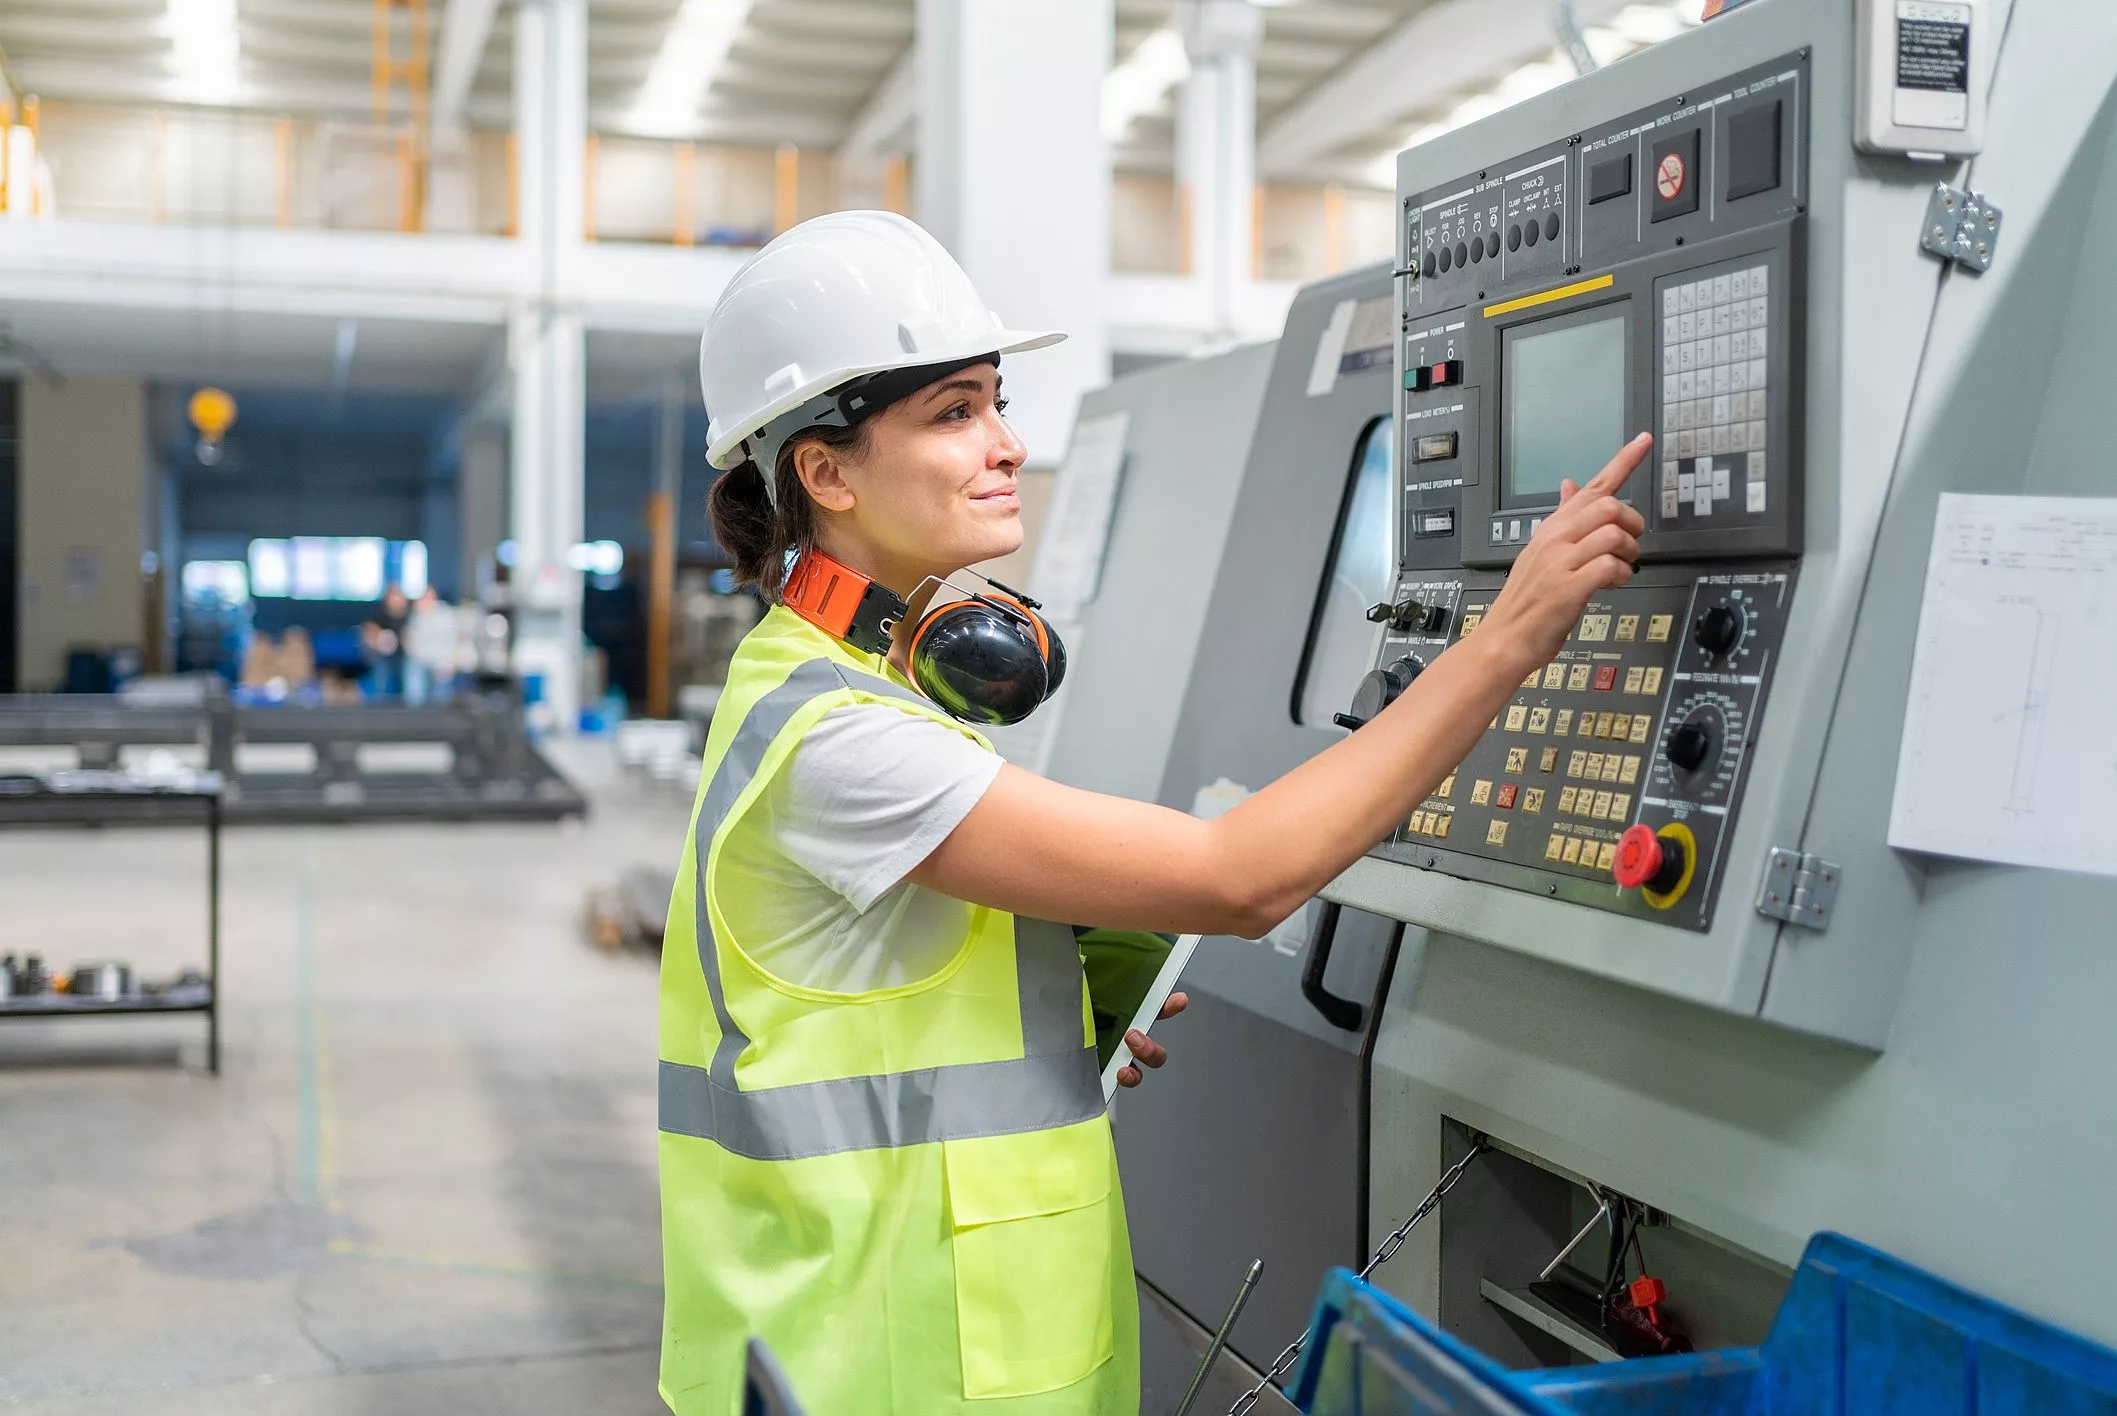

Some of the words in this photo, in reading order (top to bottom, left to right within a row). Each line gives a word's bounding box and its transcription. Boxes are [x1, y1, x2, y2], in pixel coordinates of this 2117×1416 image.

[1749, 76, 1776, 93] COUNTER
[1656, 115, 1672, 127] WORK
[1673, 105, 1697, 121] COUNTER
[1592, 138, 1606, 149] TOTAL
[1608, 130, 1630, 145] COUNTER
[1475, 183, 1485, 194] SUB
[1486, 176, 1503, 190] SPINDLE
[1521, 178, 1537, 191] CHUCK
[1554, 184, 1562, 192] EXT
[1508, 197, 1521, 208] CLAMP
[1523, 191, 1541, 203] UNCLAMP
[1439, 206, 1456, 220] SPINDLE
[1489, 205, 1499, 215] STOP
[1473, 212, 1481, 220] REV
[1424, 227, 1437, 237] SELECT
[1429, 327, 1444, 337] POWER
[1421, 408, 1432, 418] LOAD
[1418, 480, 1432, 490] SPINDLE
